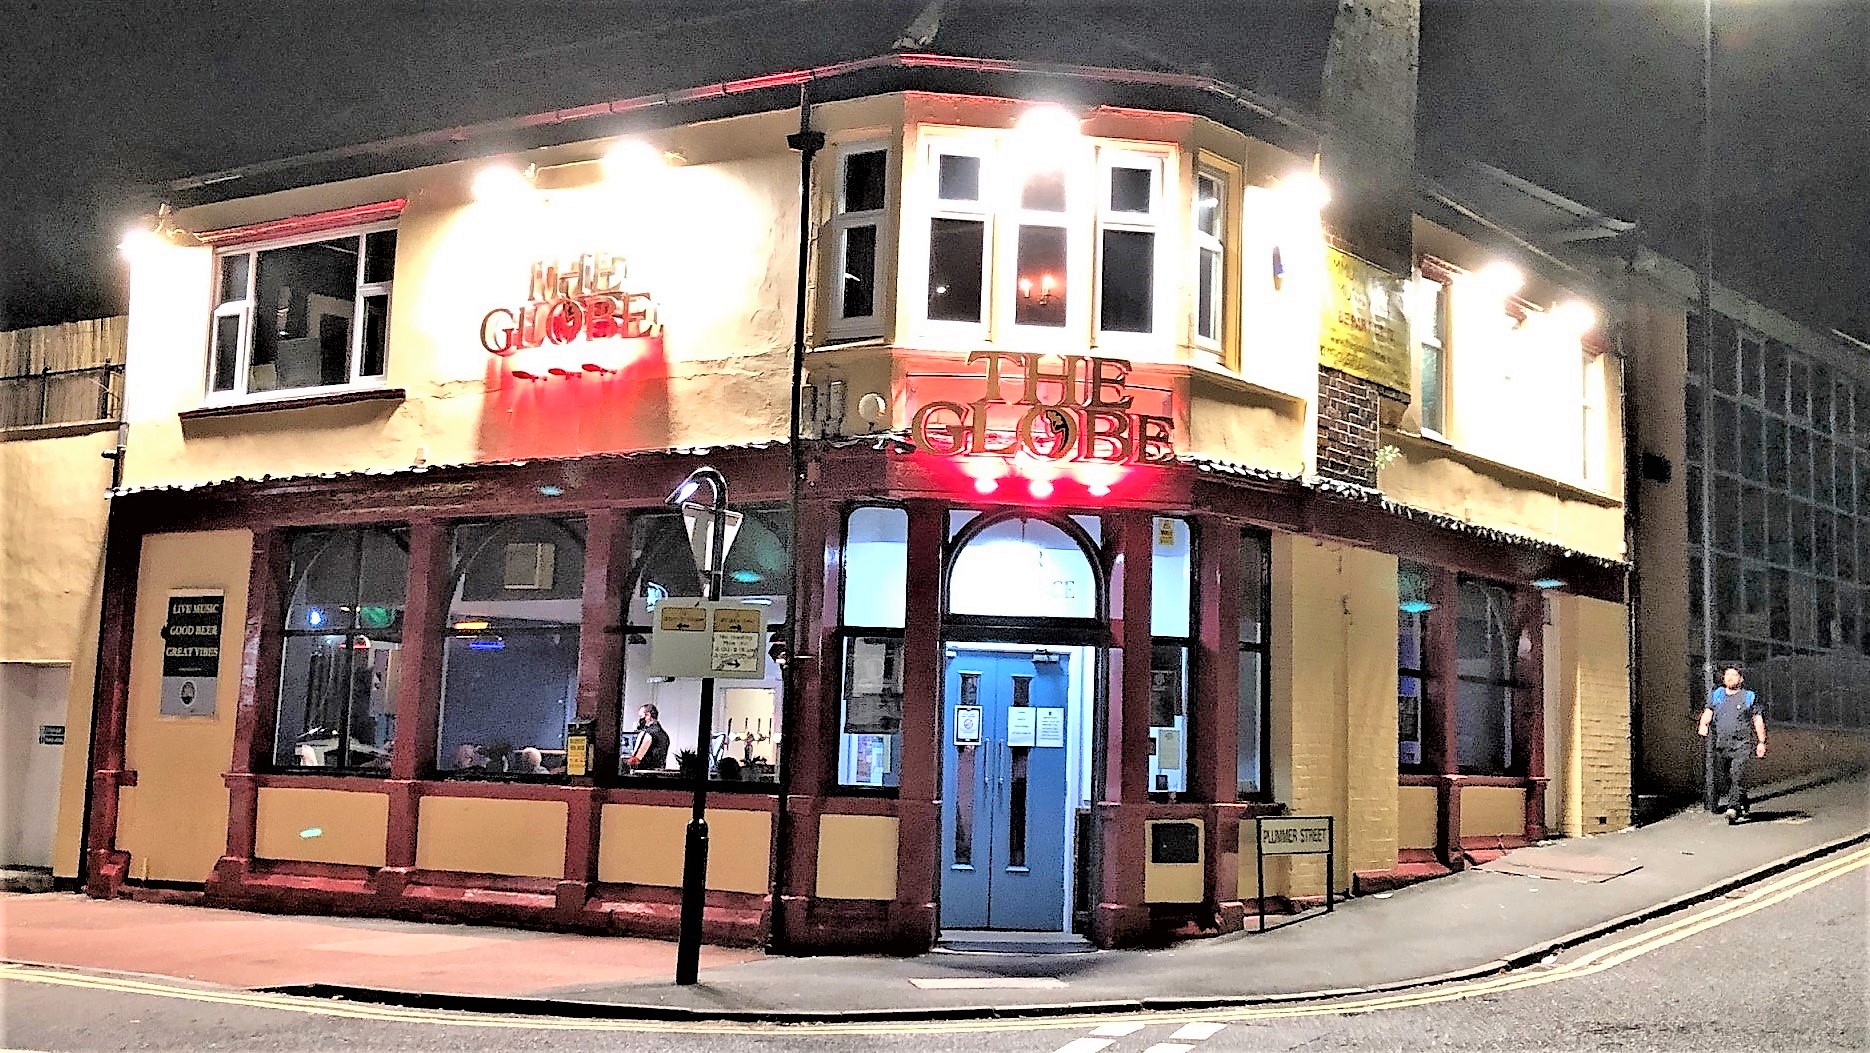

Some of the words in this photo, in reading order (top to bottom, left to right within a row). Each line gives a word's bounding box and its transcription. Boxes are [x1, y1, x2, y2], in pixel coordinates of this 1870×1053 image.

[480, 292, 653, 357] GLOBE
[966, 350, 1134, 409] THE
[911, 400, 1176, 465] GLOBE
[173, 604, 192, 613] LIVE
[193, 604, 219, 613] MUSIC
[170, 626, 194, 635] GOOD
[196, 625, 217, 635] BEER
[166, 647, 193, 656] GREAT
[195, 647, 218, 656] VIBES
[1264, 829, 1297, 843] PLUMMER
[1300, 828, 1327, 842] STREET
